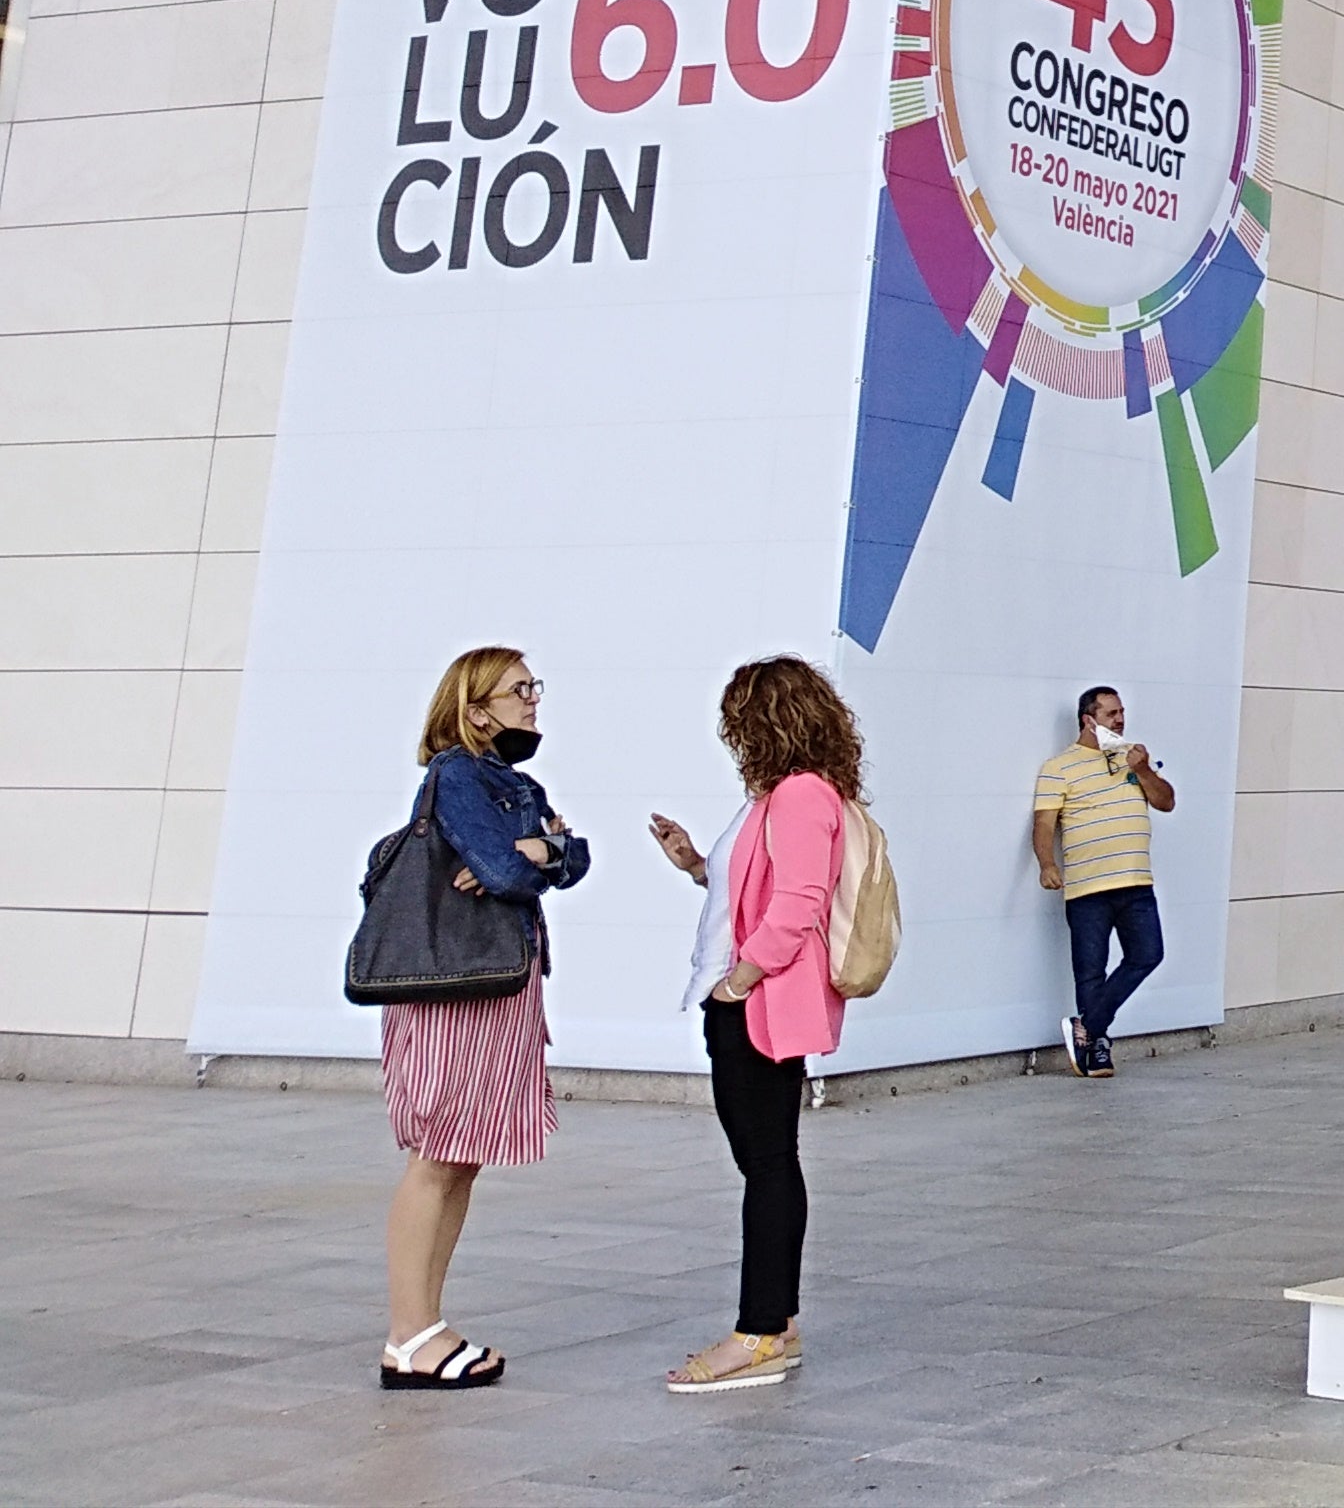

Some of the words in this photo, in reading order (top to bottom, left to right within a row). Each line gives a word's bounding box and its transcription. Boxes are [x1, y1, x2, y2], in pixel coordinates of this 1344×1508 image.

[396, 25, 540, 147] LU
[1009, 41, 1191, 145] CONGRESO
[1007, 94, 1147, 170] CONFEDERAL
[1146, 143, 1187, 182] UGT
[1009, 143, 1070, 189] 18-20
[1073, 170, 1128, 209] mayo
[1133, 184, 1179, 222] 2021
[376, 119, 662, 275] CIÓN
[1052, 195, 1135, 249] València
